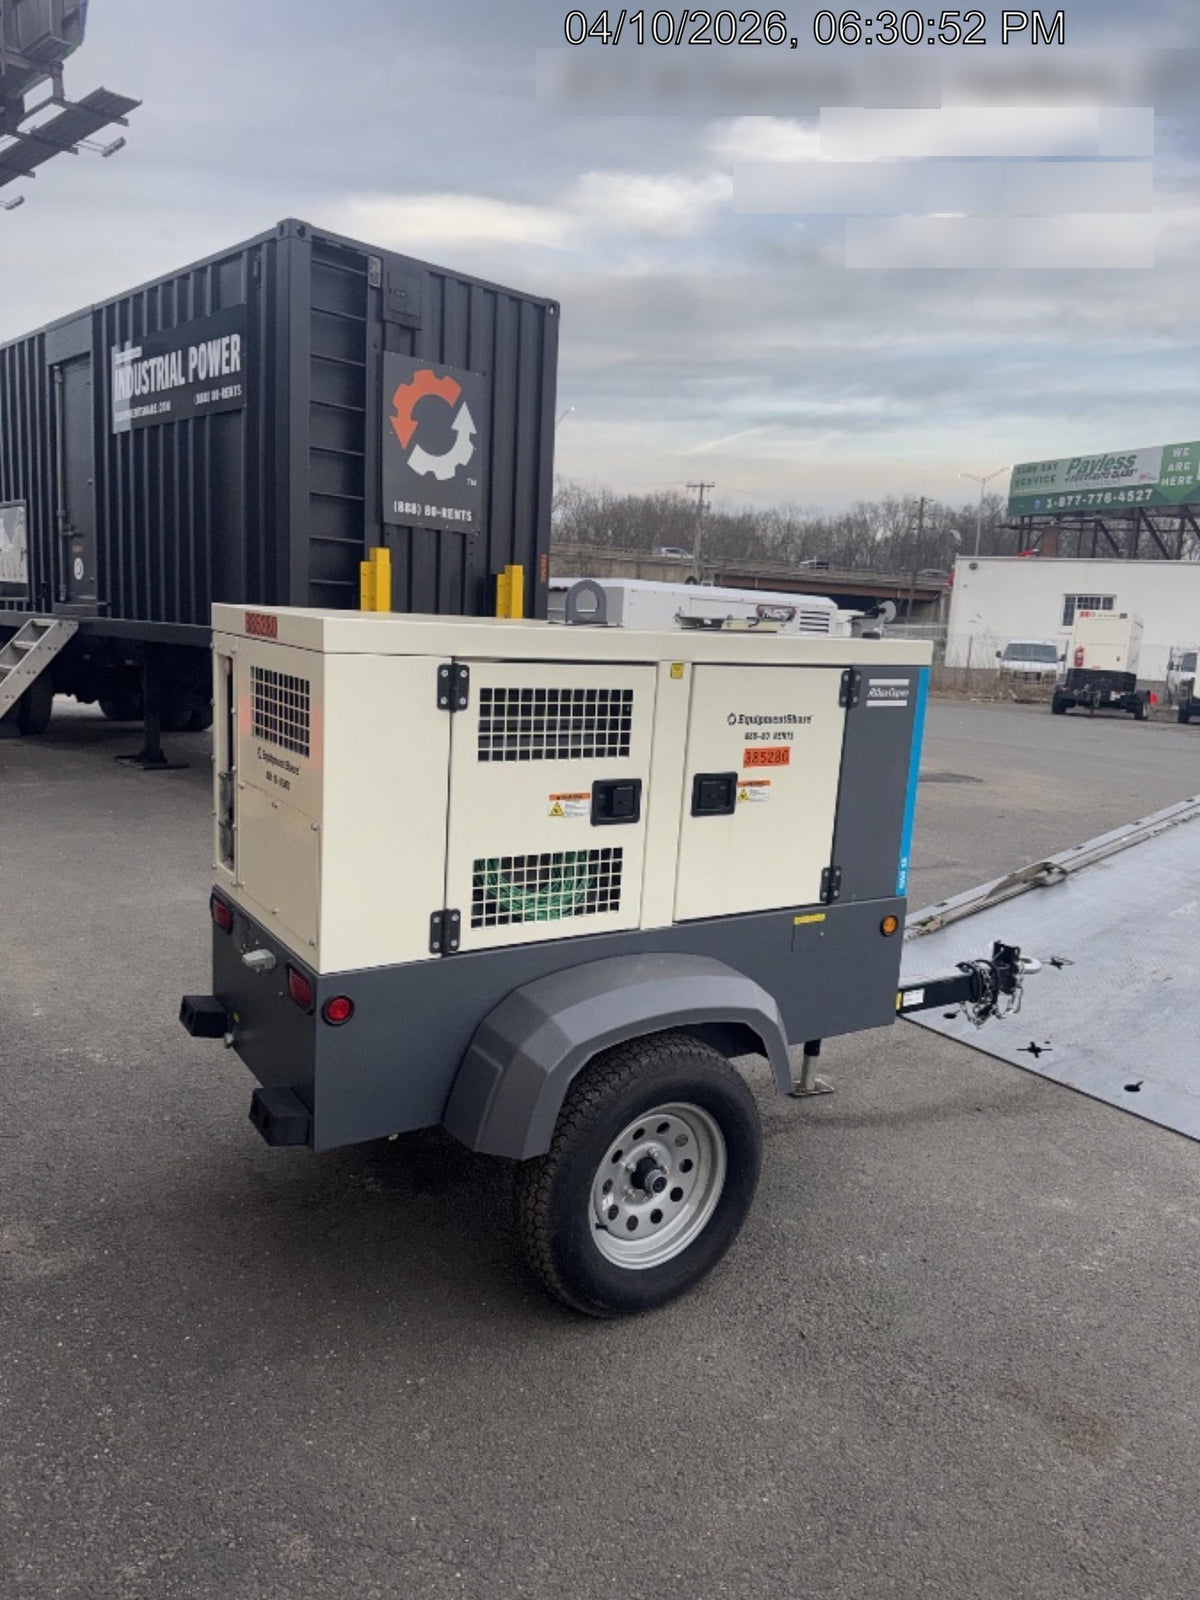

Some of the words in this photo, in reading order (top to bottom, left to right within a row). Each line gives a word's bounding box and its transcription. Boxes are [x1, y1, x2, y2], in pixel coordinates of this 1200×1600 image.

[114, 350, 186, 402] INDUSTRIAL
[188, 334, 241, 383] POWER
[1172, 447, 1190, 457] WE
[1066, 454, 1137, 475] Payless
[1168, 461, 1192, 472] ARE
[1161, 475, 1193, 486] HERE
[393, 501, 421, 516] (888)
[424, 504, 472, 522] 80-RENTS
[744, 749, 788, 765] 385280
